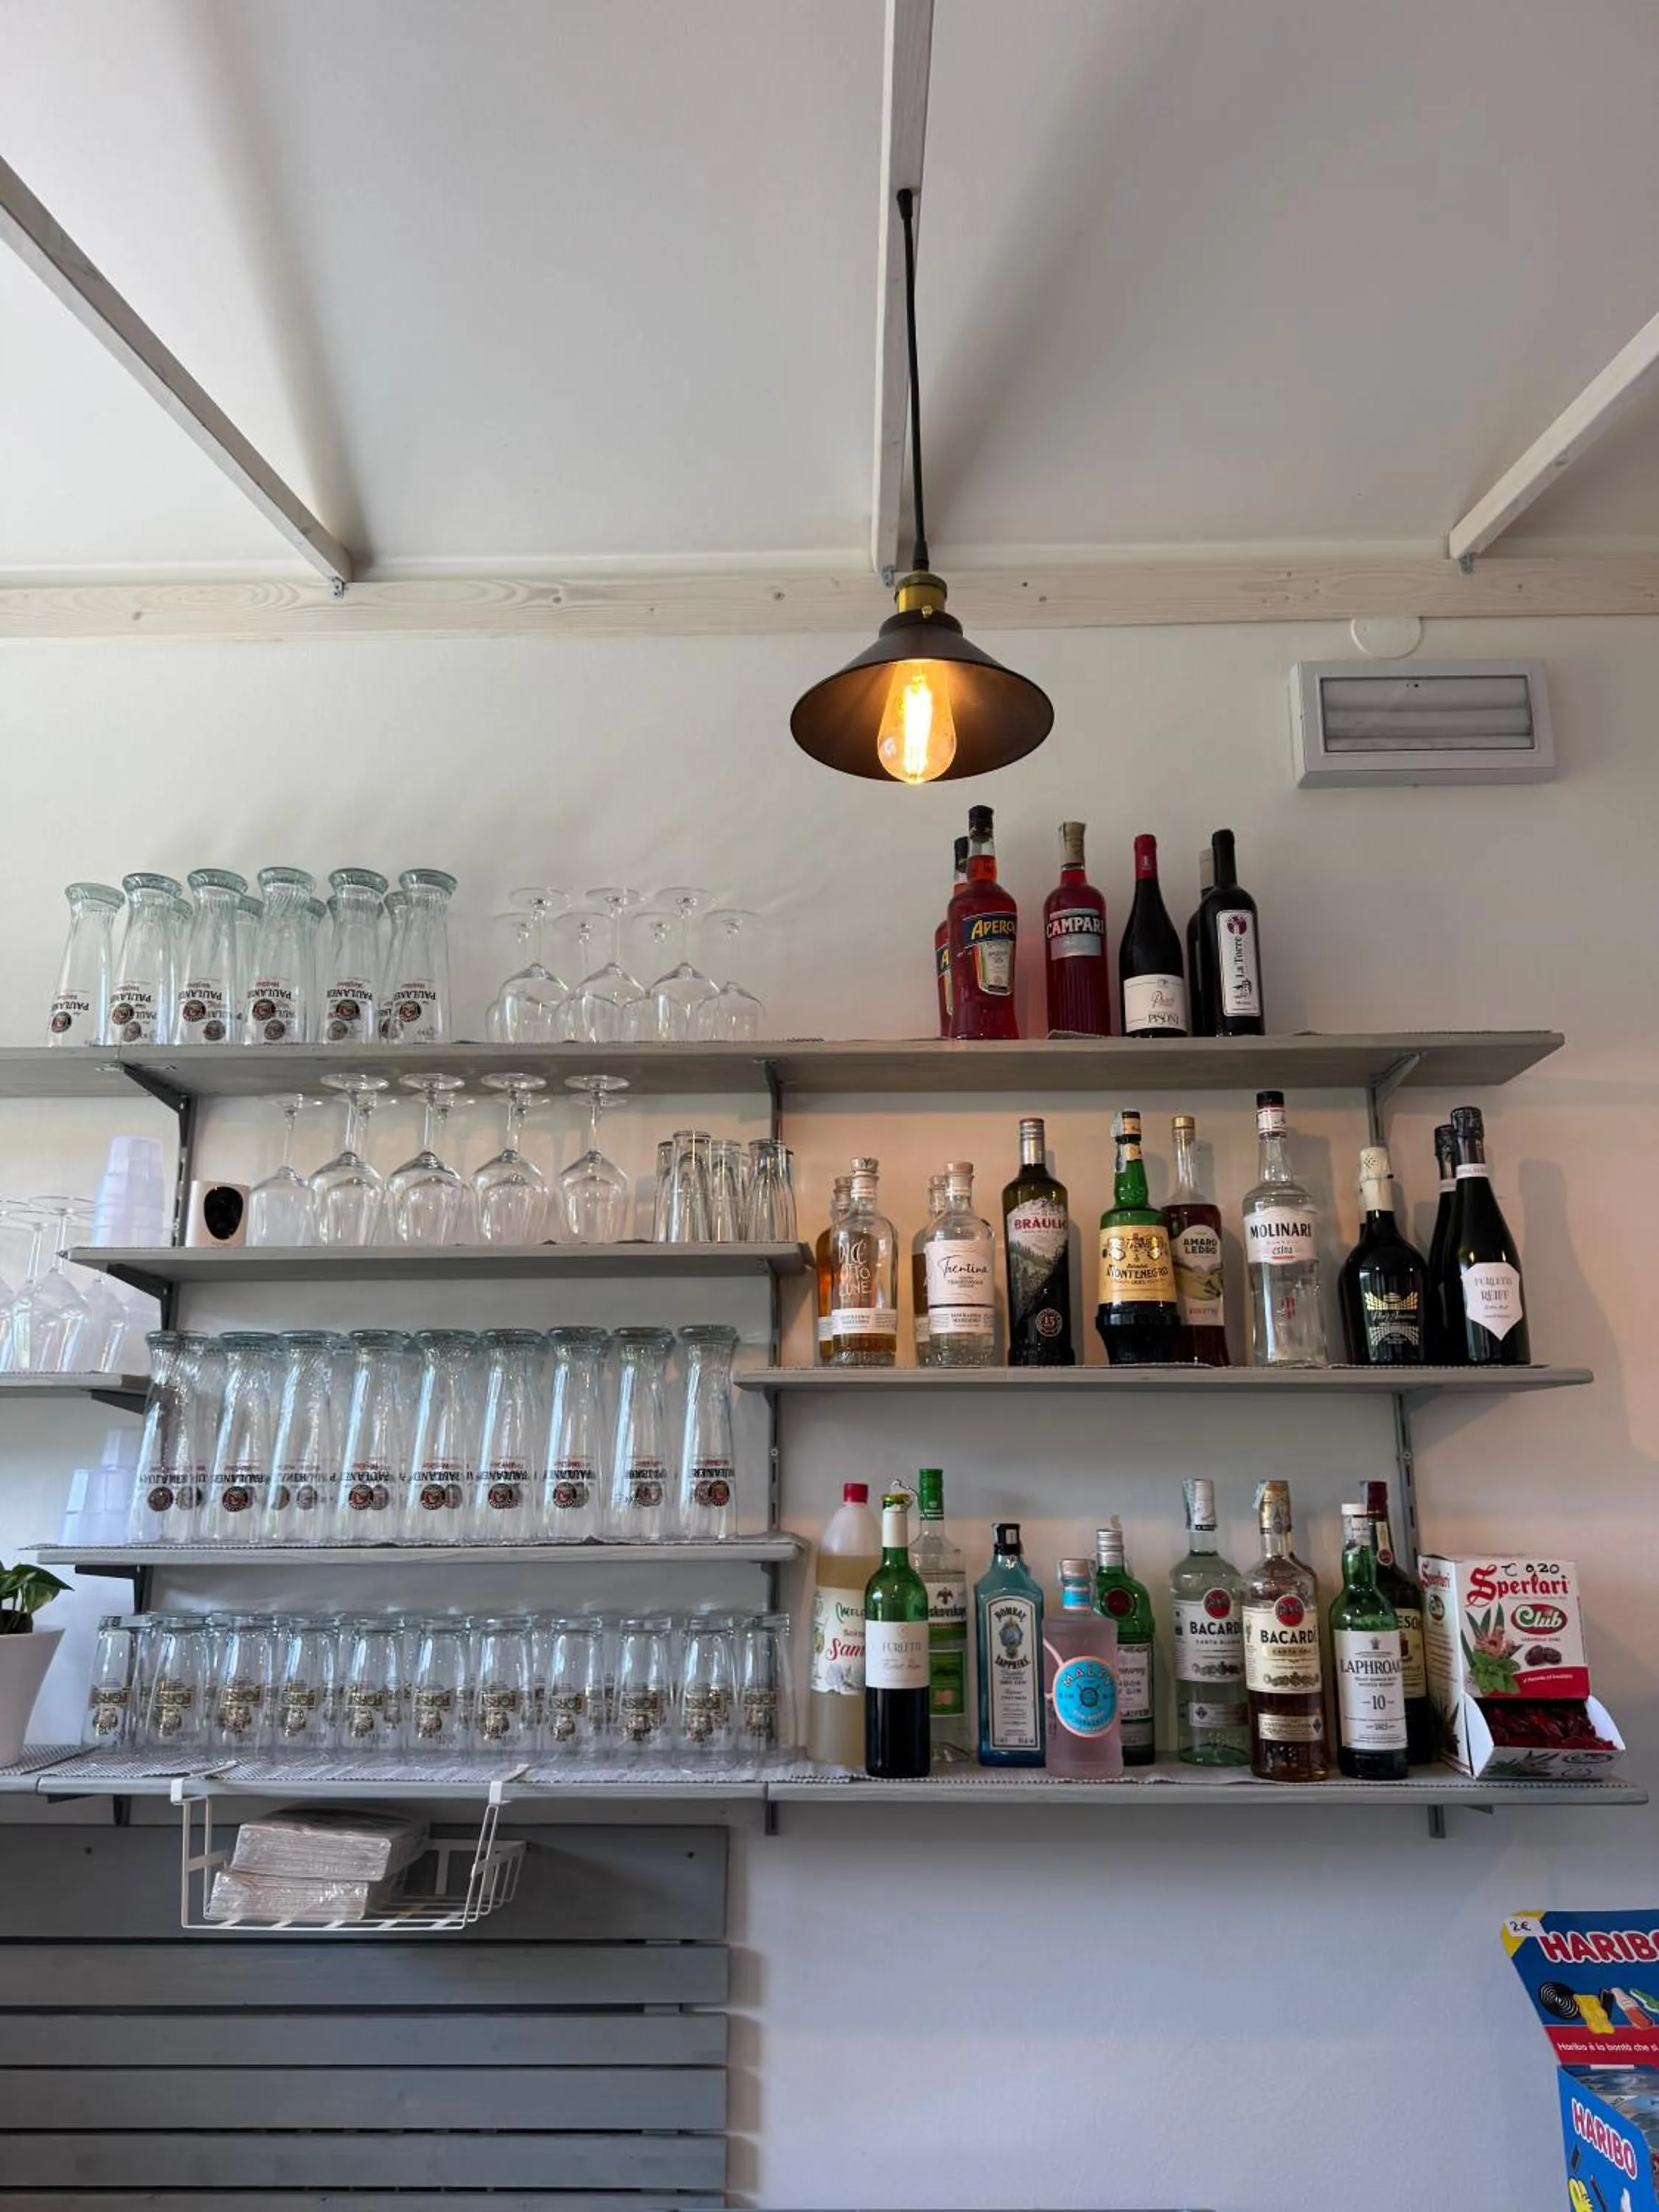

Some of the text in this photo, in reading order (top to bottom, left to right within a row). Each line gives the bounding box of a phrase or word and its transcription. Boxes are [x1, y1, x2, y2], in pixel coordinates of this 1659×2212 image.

[970, 919, 1016, 940] APERO
[1046, 917, 1104, 939] CAMPARI
[1251, 1222, 1312, 1239] MOLINARI
[1044, 1315, 1056, 1326] 15
[994, 1606, 1027, 1622] BOMBAY
[1516, 1606, 1562, 1627] Club
[1190, 1621, 1241, 1635] BACARD
[994, 1655, 1031, 1670] SAPPHIRE
[1372, 1694, 1386, 1710] 10
[1557, 2042, 1587, 2051] Haribo
[1571, 2097, 1638, 2180] HARIBO
